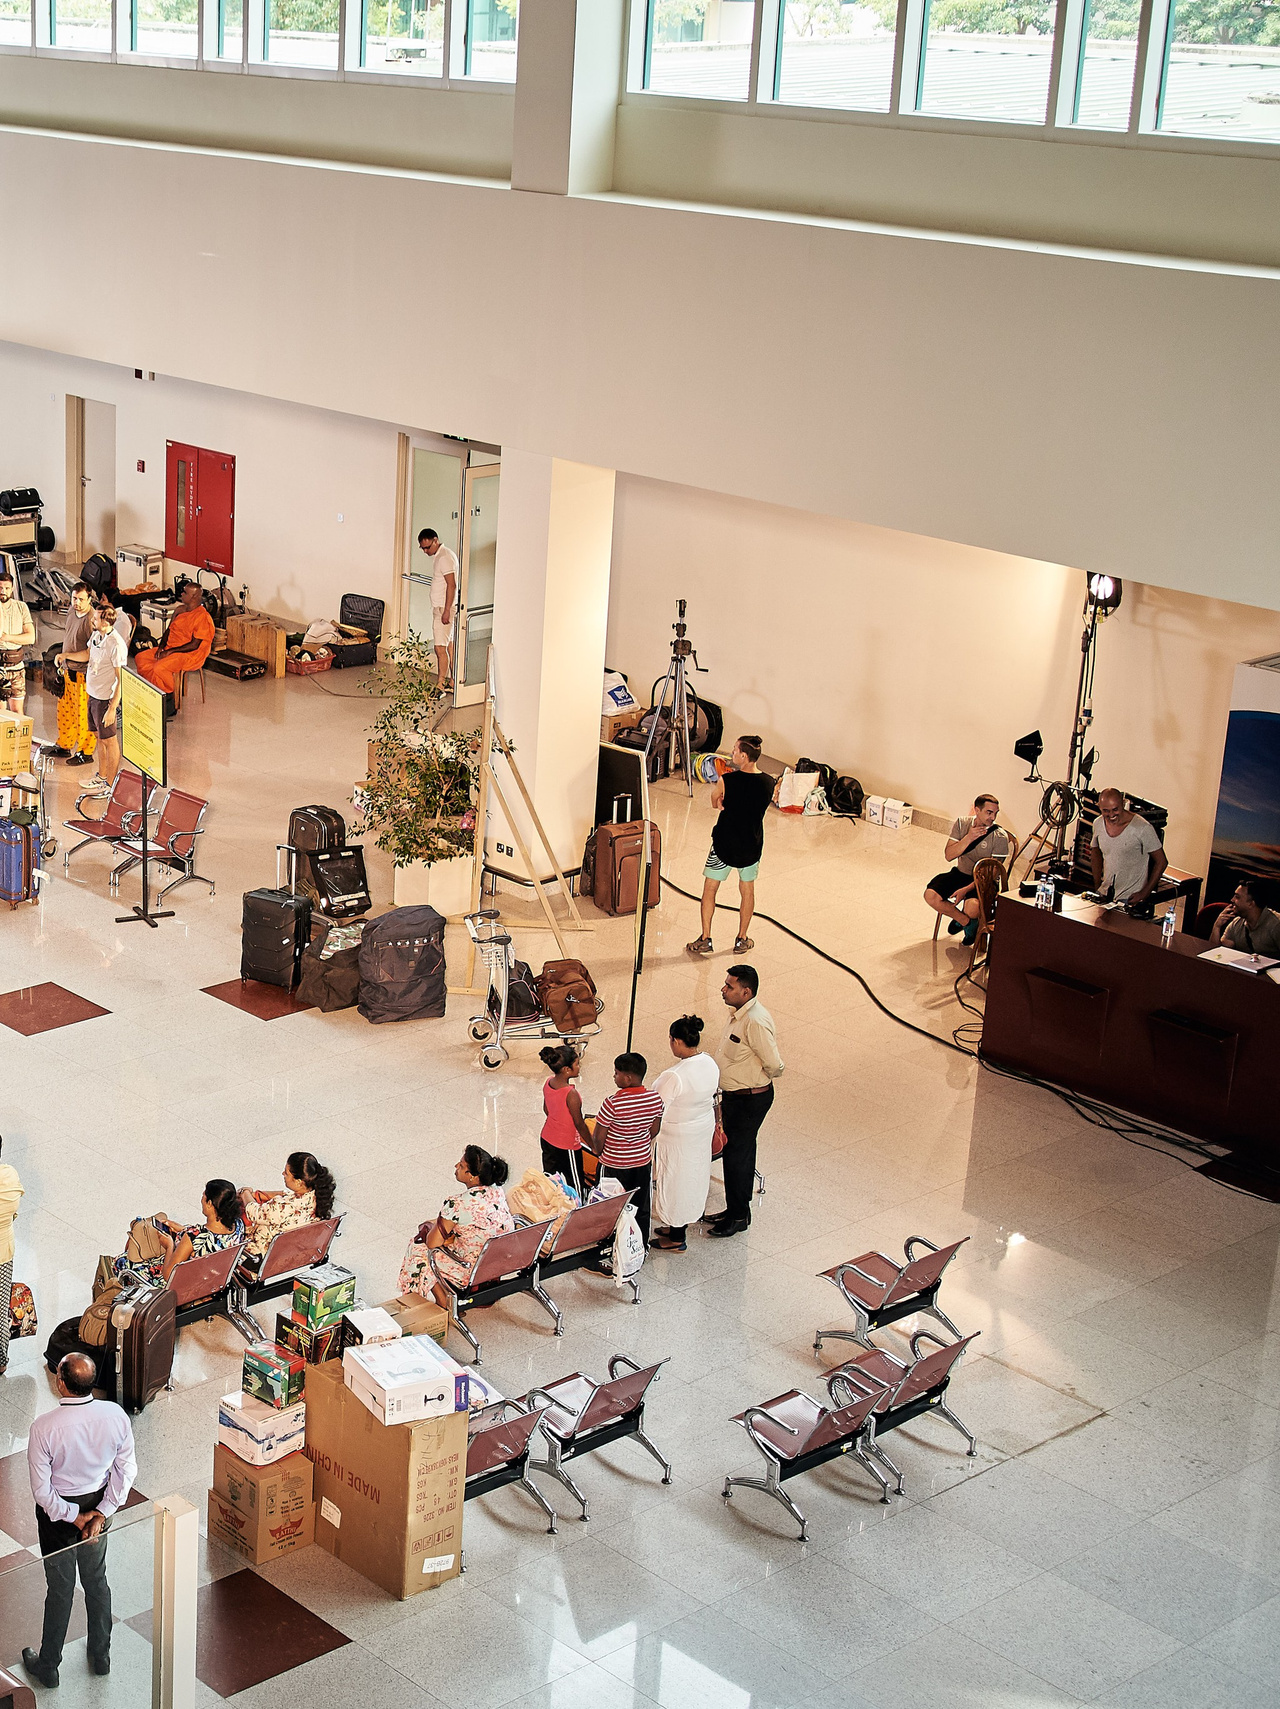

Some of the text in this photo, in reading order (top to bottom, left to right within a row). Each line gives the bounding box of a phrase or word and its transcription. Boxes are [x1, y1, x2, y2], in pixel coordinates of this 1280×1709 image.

[305, 1443, 381, 1505] MADE IN CHIN
